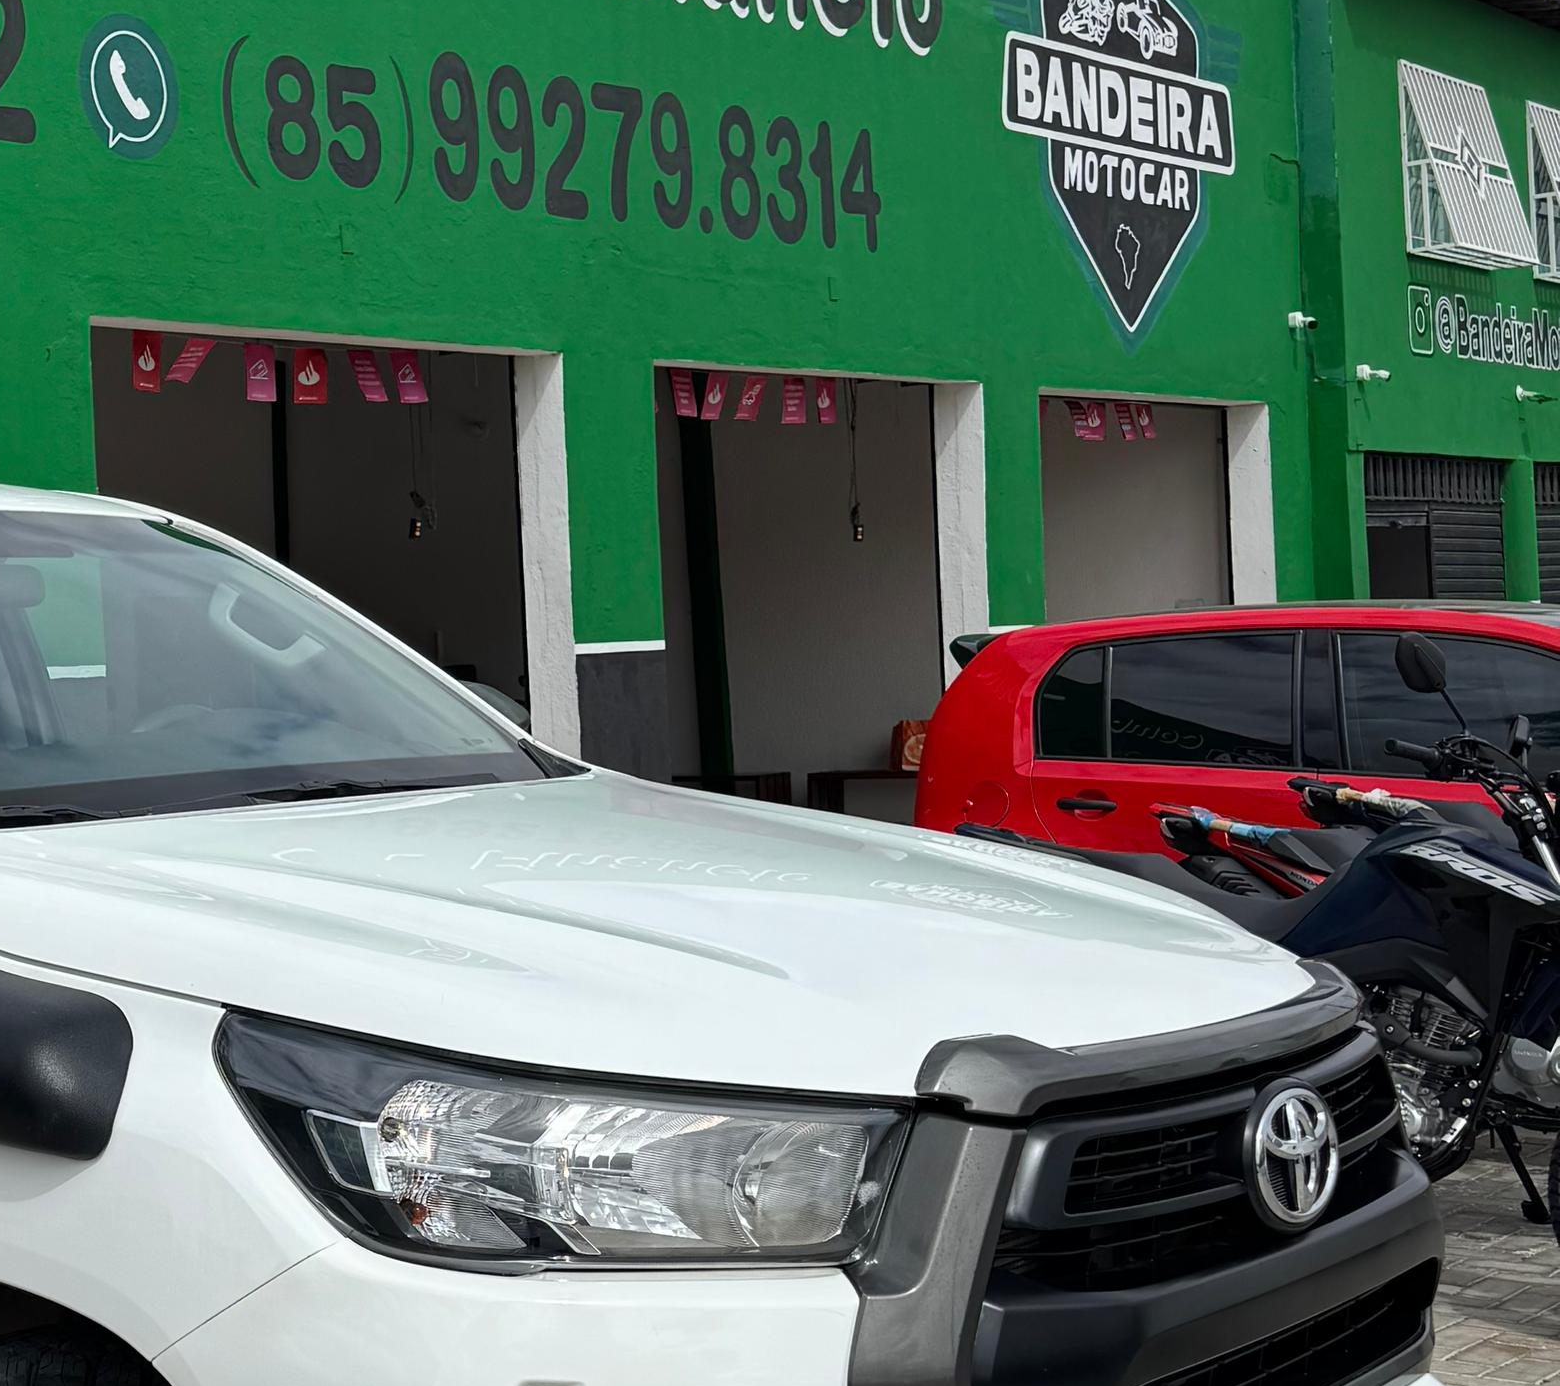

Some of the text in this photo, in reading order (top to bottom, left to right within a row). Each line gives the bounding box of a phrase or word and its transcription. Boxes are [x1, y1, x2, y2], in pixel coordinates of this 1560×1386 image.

[1016, 47, 1223, 159] BANDEIRA
[1063, 147, 1190, 210] MOTOCAR
[1435, 294, 1560, 371] @BandeiraMo
